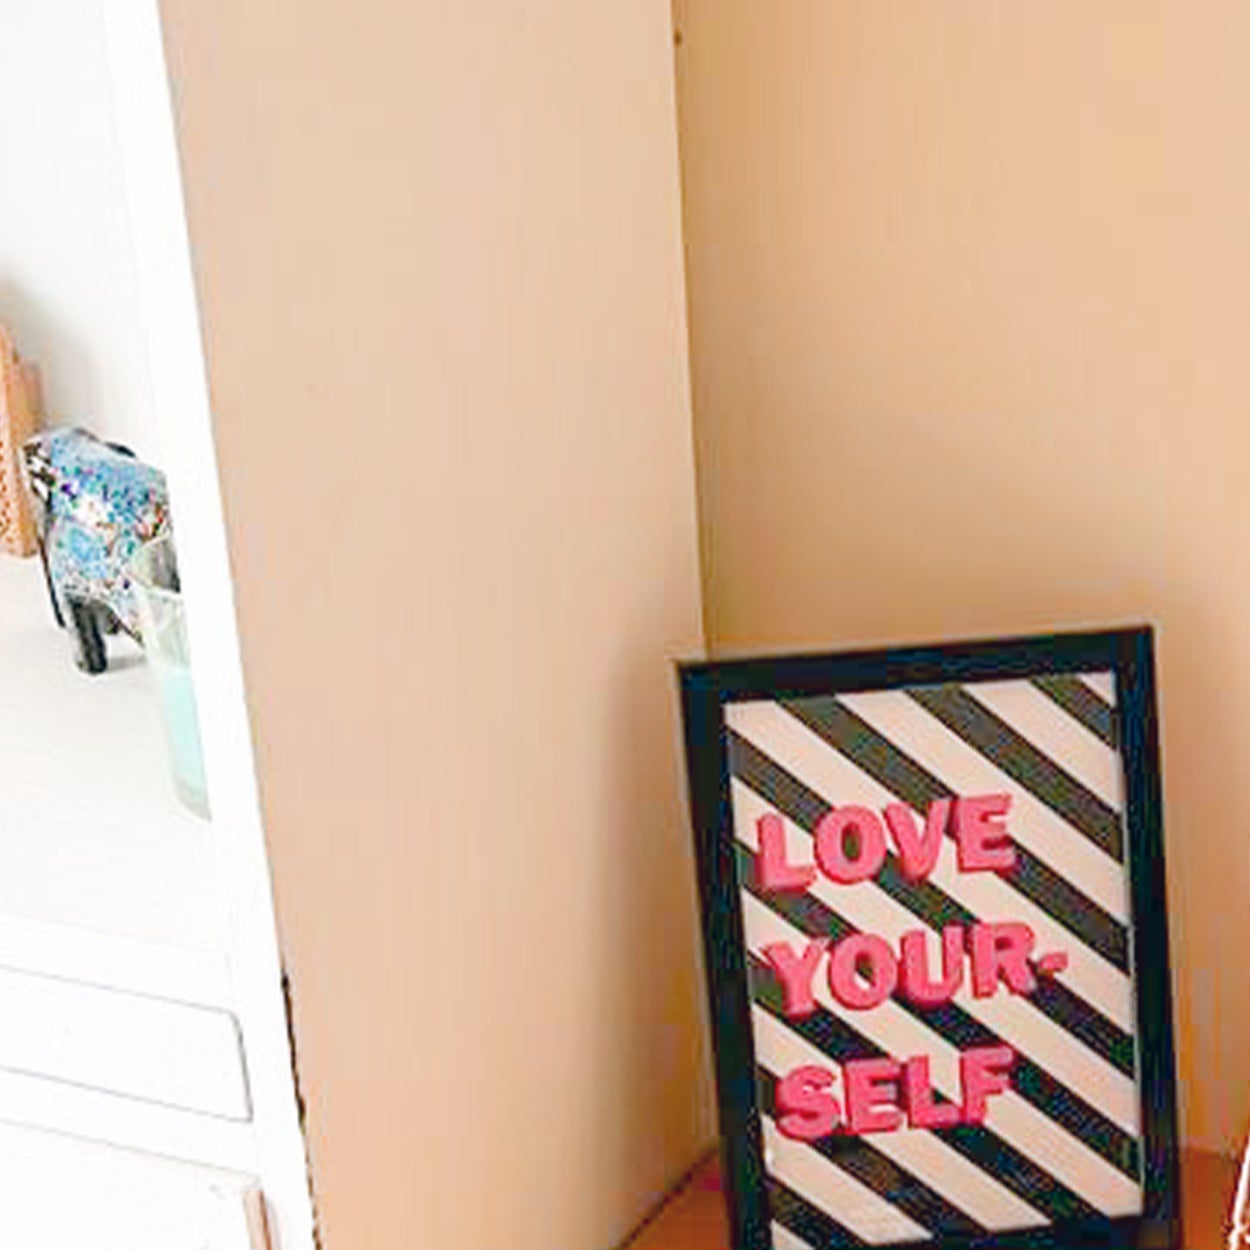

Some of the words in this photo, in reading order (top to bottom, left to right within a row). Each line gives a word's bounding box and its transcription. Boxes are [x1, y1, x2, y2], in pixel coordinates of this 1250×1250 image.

[754, 792, 1018, 893] LOVE
[762, 921, 1069, 1019] YOUR-
[774, 1045, 1014, 1142] SELF
